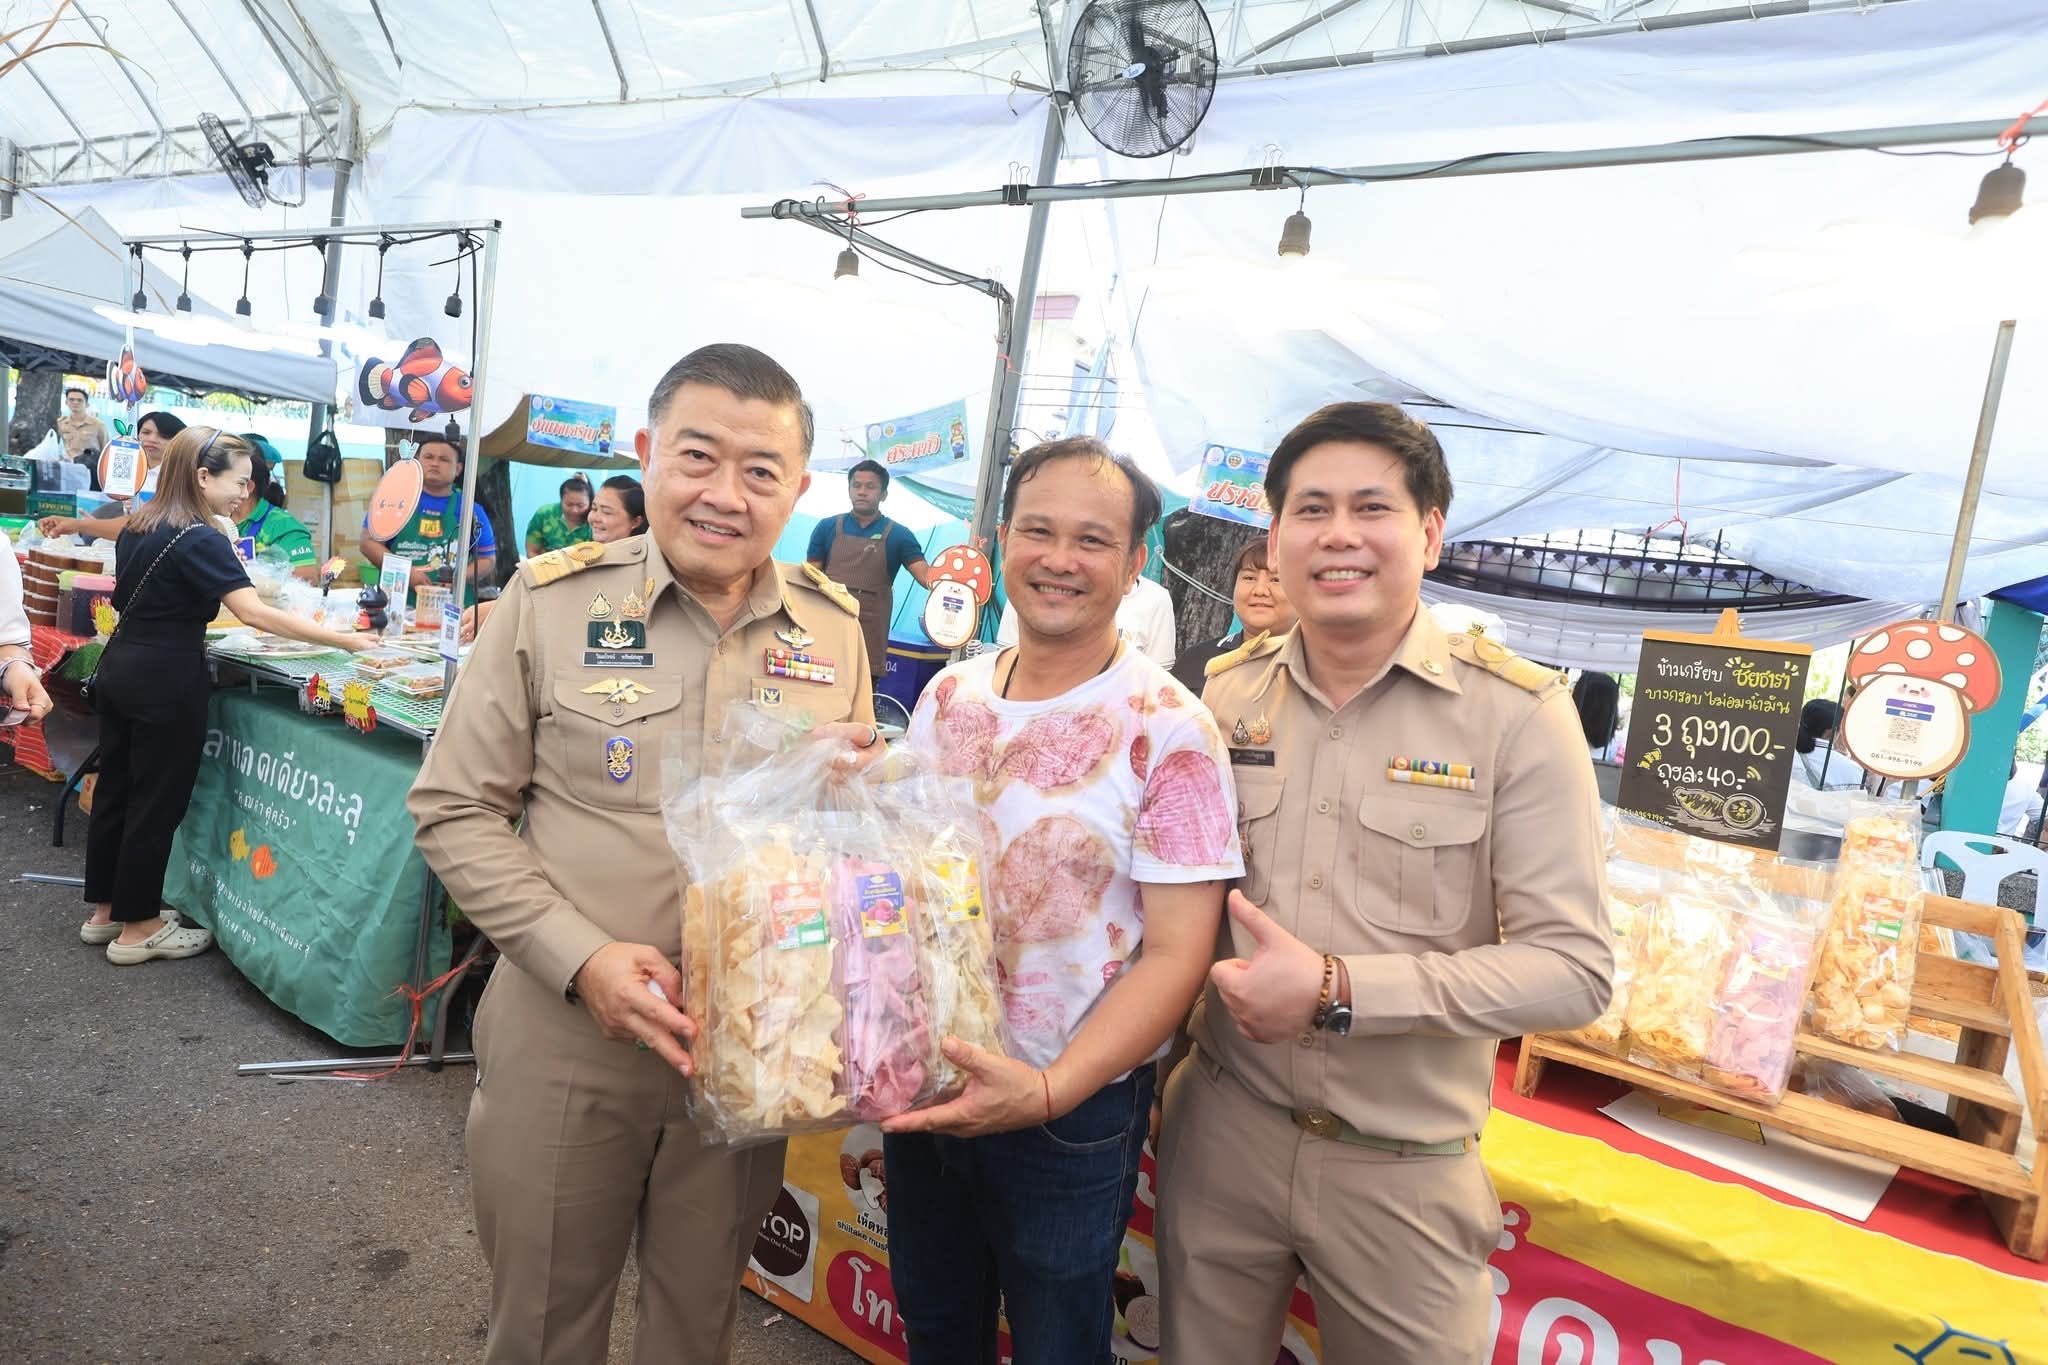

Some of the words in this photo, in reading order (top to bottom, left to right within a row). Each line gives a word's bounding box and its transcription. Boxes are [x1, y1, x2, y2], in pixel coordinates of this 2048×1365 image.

[1657, 658, 1723, 683] ข้าวเกรียบ
[1732, 662, 1791, 690] ชัยธารา
[1652, 713, 1673, 747] 3
[202, 728, 363, 845] ลาแดดเดียวละลุ
[761, 1210, 805, 1244] TOP
